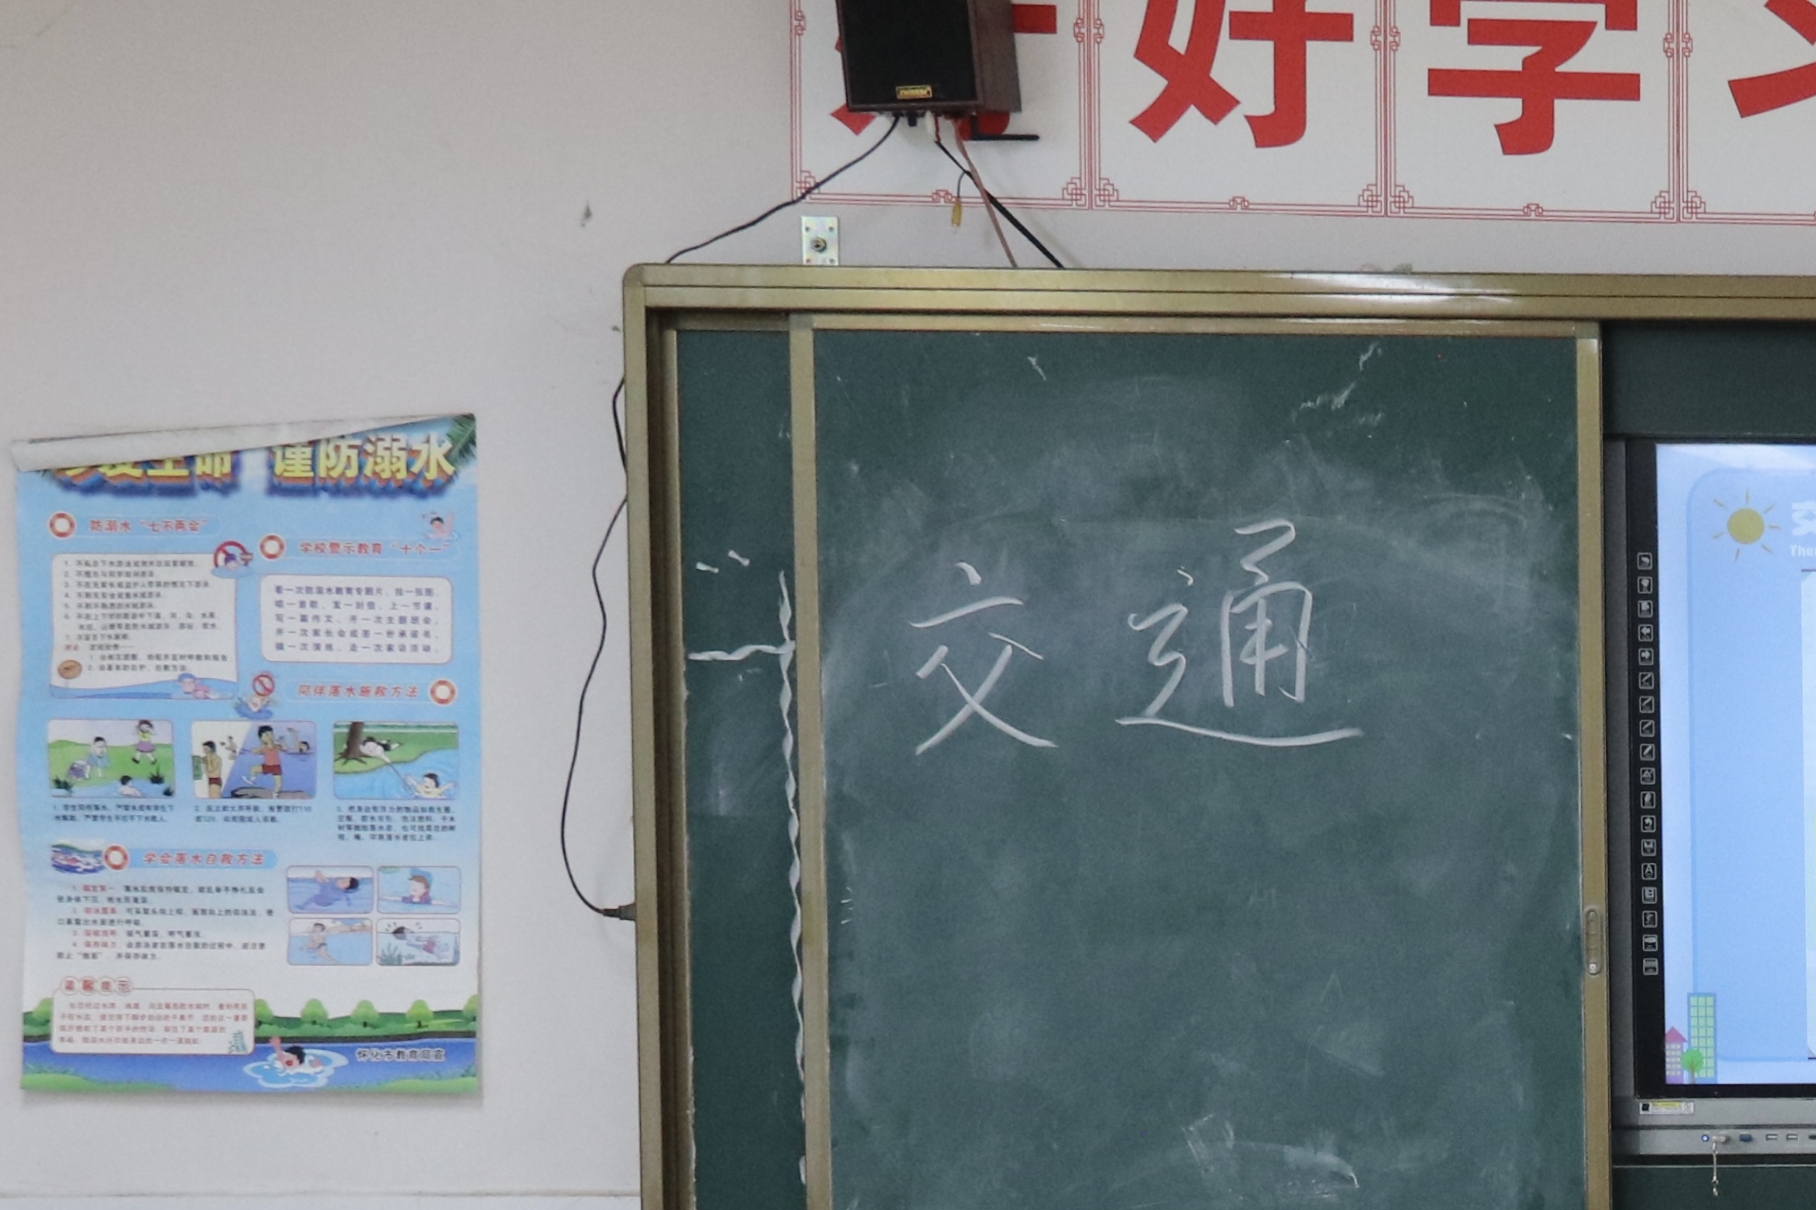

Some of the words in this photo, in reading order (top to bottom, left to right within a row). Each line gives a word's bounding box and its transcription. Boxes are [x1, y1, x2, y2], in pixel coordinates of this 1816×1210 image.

[273, 431, 456, 480] 谨防溺水
[909, 518, 1364, 756] 交通
